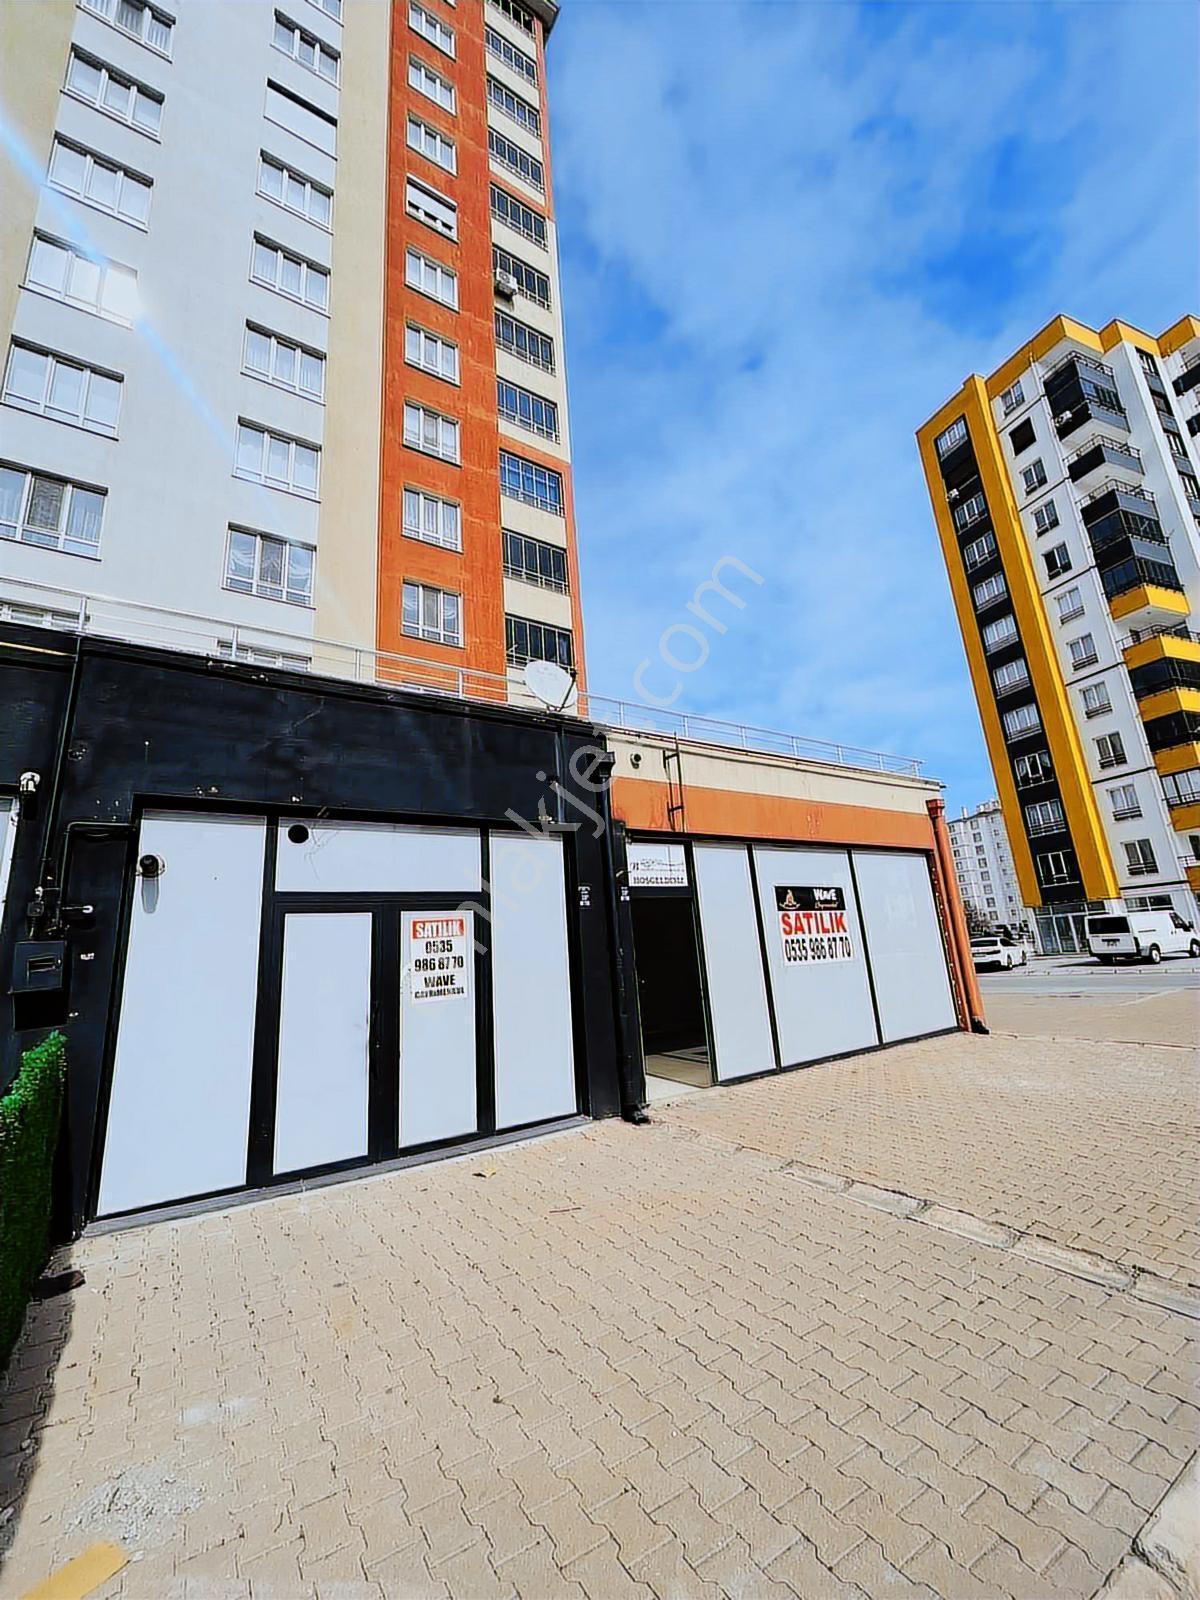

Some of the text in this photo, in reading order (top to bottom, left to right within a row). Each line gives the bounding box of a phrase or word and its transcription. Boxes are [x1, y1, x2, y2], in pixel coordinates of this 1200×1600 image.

[415, 919, 462, 938] SATILIK
[781, 912, 847, 935] SATILIK
[425, 939, 453, 954] 0535
[785, 938, 808, 962] 0535
[809, 937, 826, 960] 986
[414, 958, 436, 972] 986
[424, 974, 455, 988] WAVE
